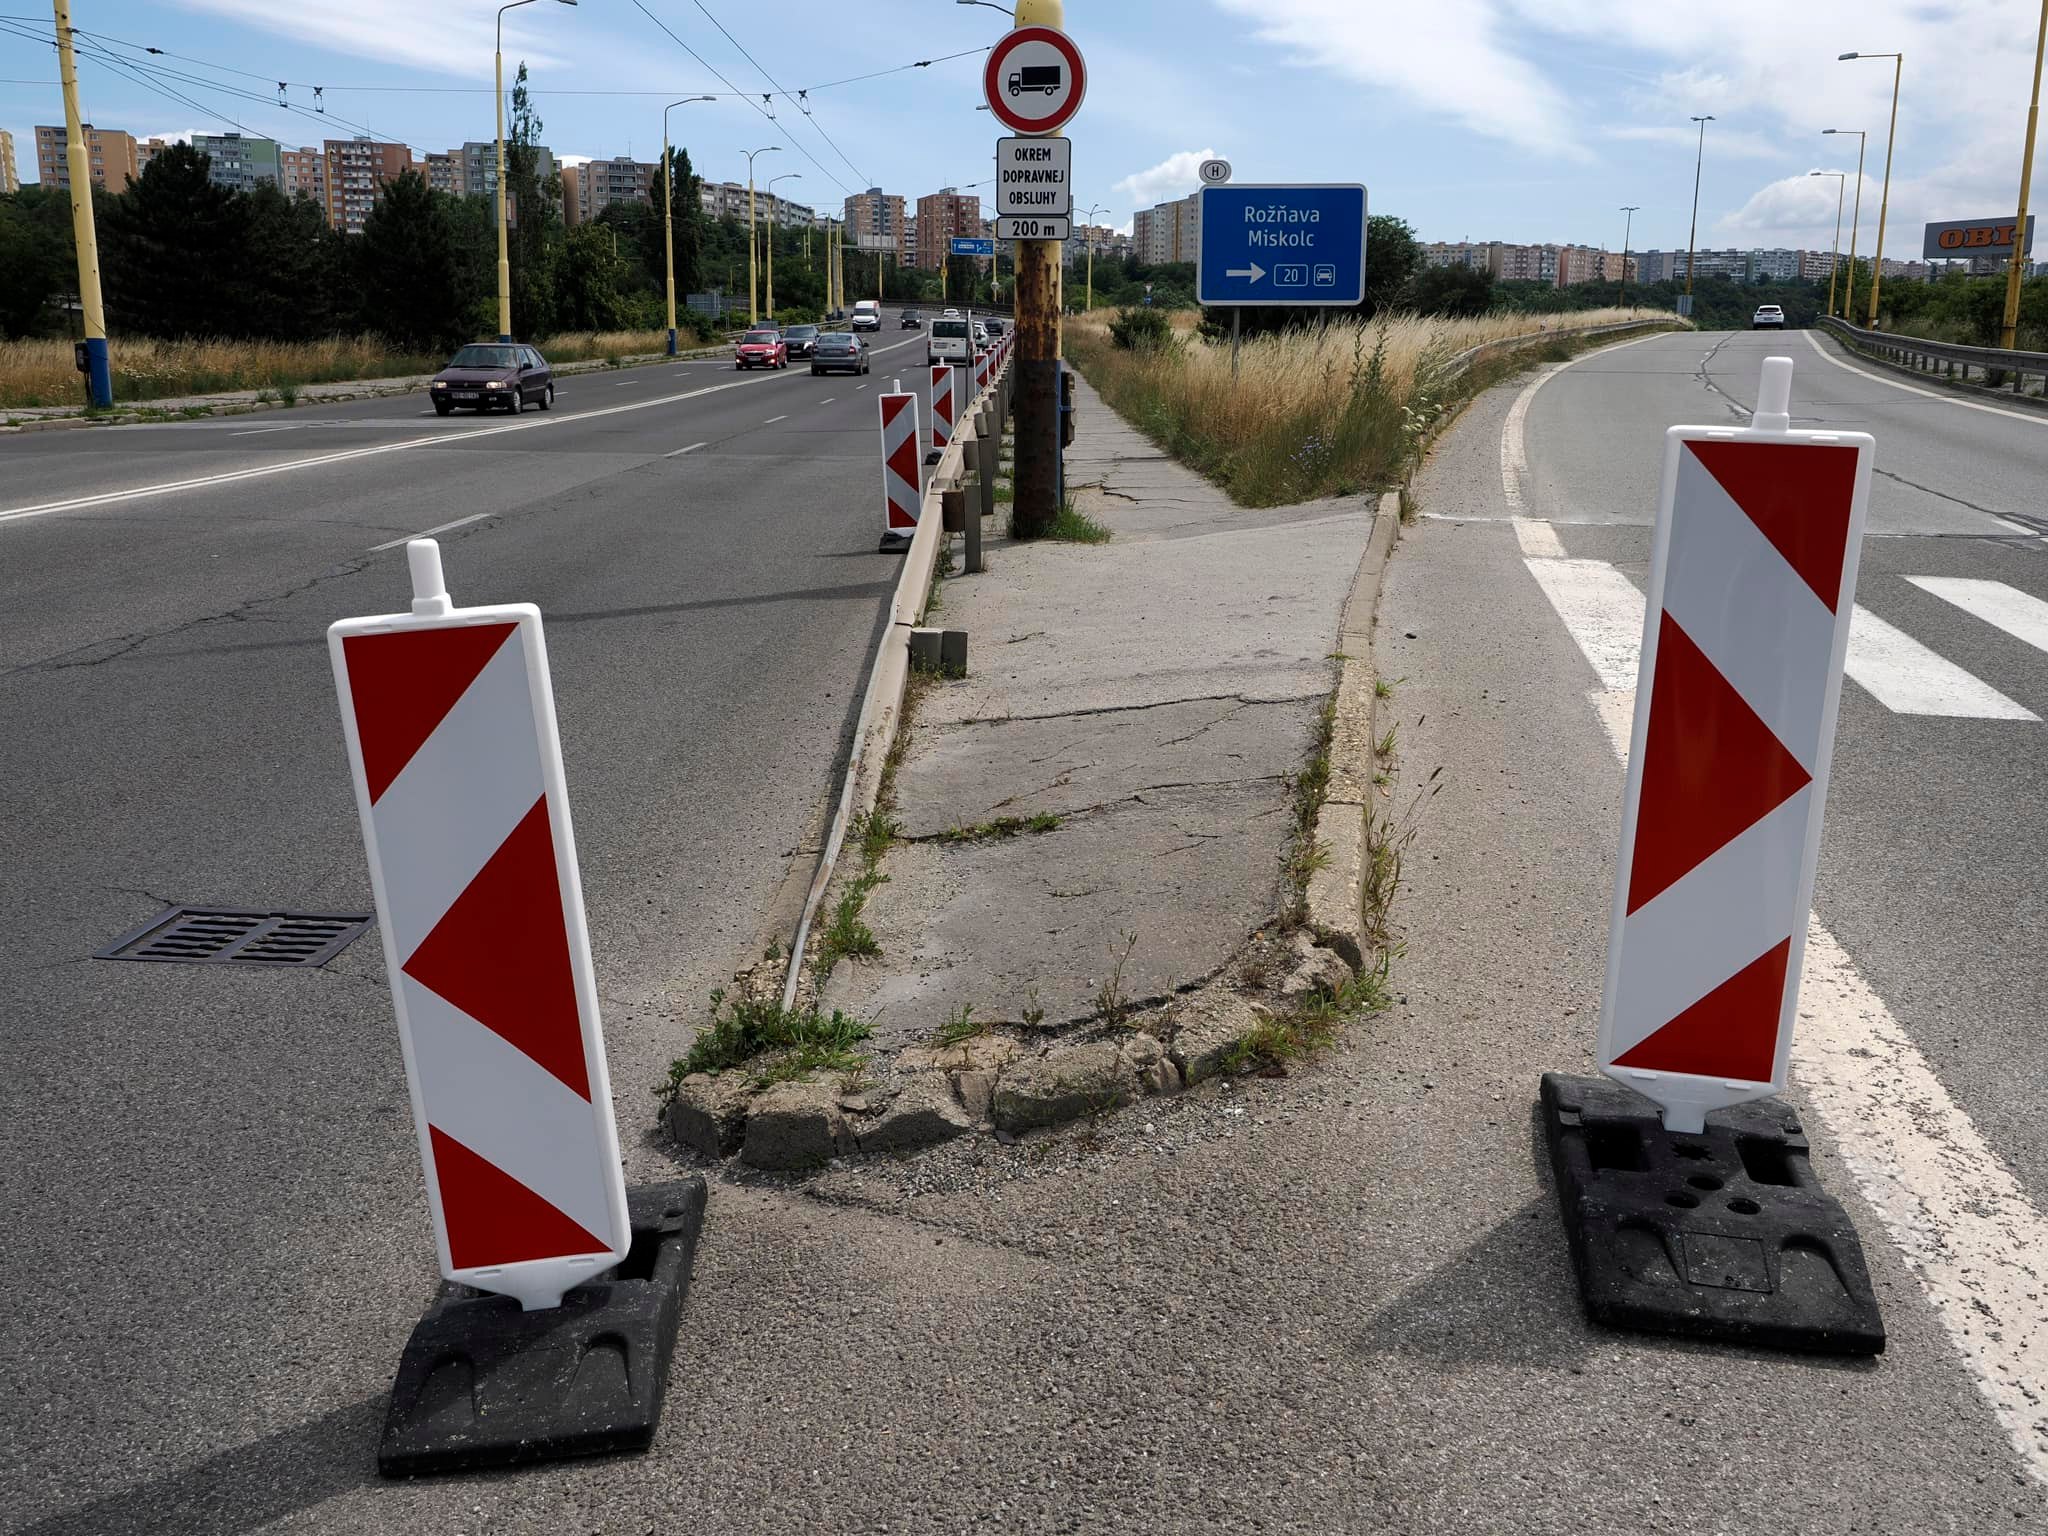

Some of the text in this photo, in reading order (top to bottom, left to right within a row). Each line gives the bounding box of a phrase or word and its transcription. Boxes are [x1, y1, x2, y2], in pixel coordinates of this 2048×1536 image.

[1015, 148, 1051, 161] OKREM
[1003, 170, 1064, 183] DOPRAVNEJ
[1211, 165, 1220, 177] H
[1009, 191, 1057, 205] OBSLUHY
[1244, 205, 1320, 223] Rožňava
[1012, 220, 1055, 236] 200 m
[1248, 229, 1315, 247] Miskolc
[1938, 225, 2018, 249] OBI
[1283, 268, 1299, 283] 20
